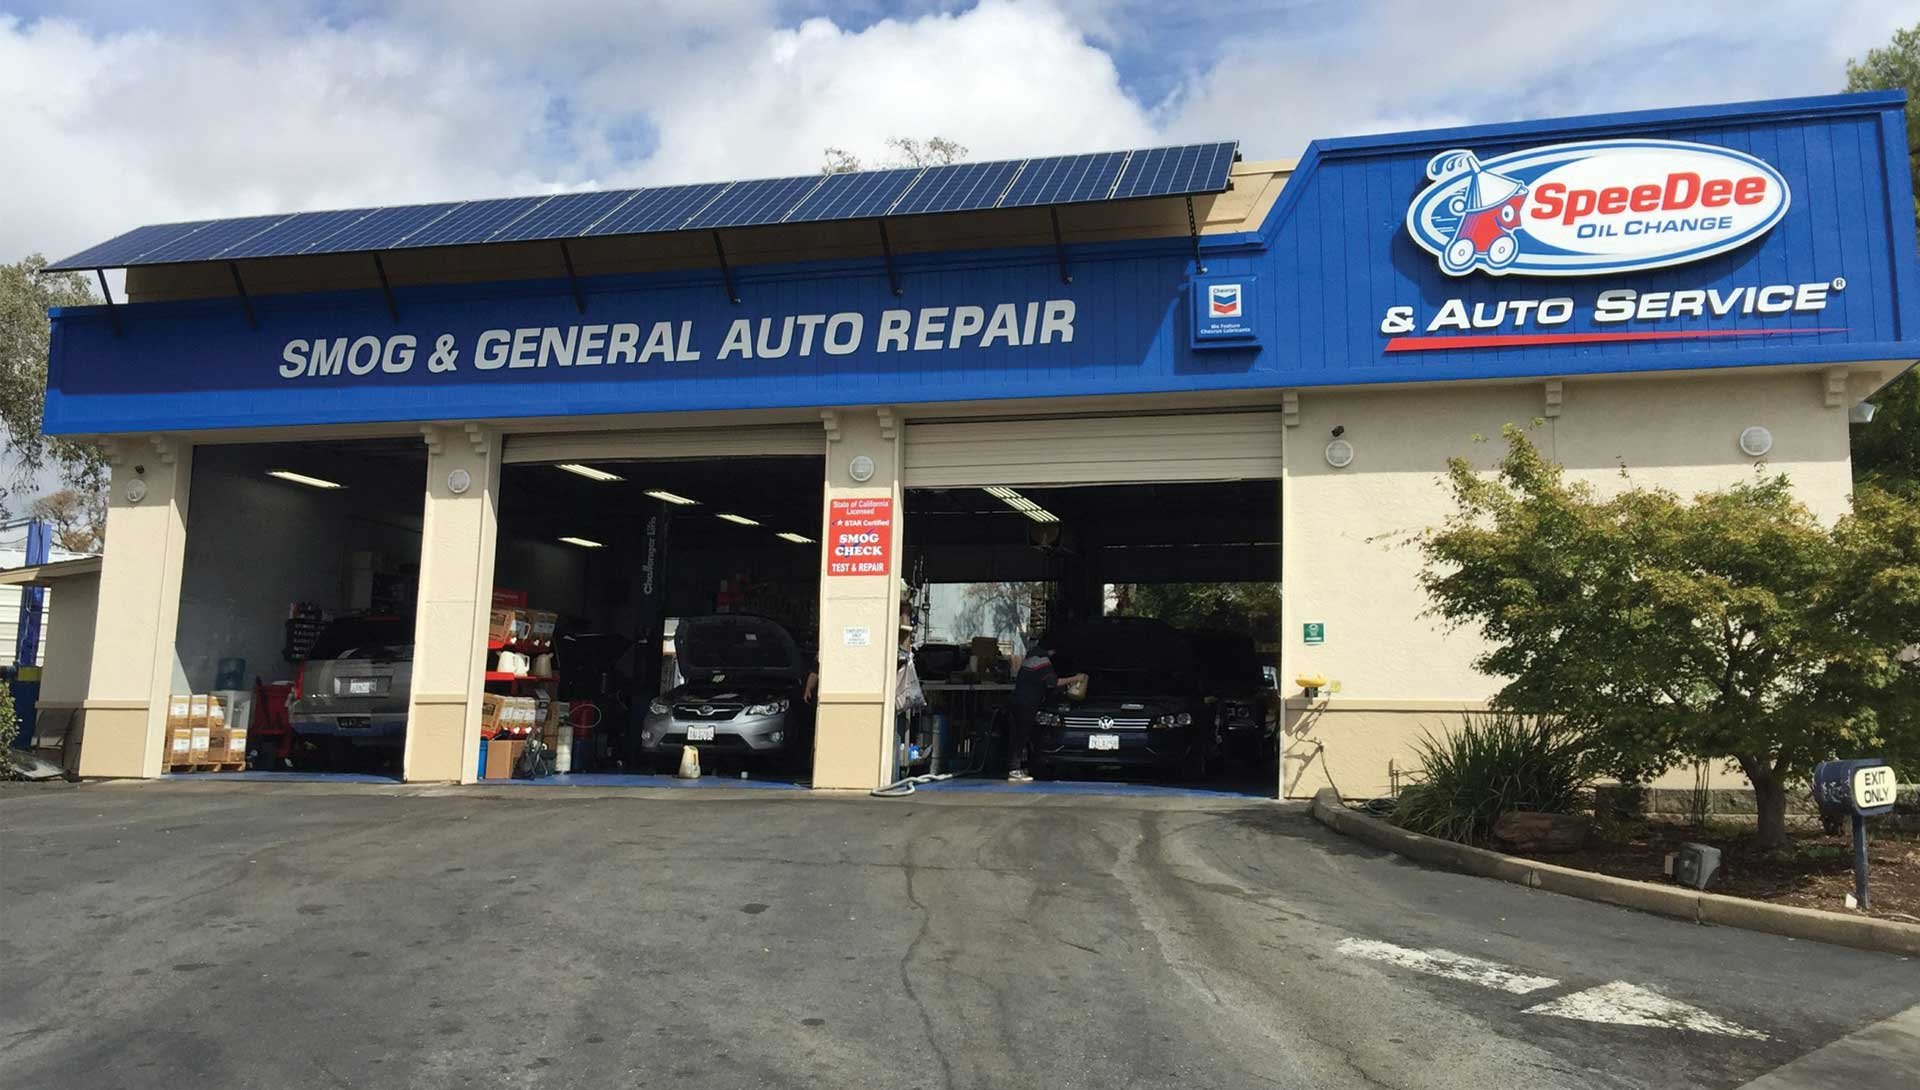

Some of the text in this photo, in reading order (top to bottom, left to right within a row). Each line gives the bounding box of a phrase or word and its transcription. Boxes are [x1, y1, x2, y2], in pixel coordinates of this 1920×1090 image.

[1530, 172, 1767, 226] SpeeDee
[1576, 215, 1733, 239] OIL CHANGE
[1380, 305, 1414, 334] &
[1427, 297, 1574, 332] AUTO
[278, 299, 1077, 379] SMOG & GENERAL AUTO REPAIR
[847, 507, 875, 515] Licensed
[839, 533, 879, 544] SMOG
[834, 545, 883, 557] CHECK
[642, 537, 656, 595] Challenger
[832, 562, 884, 572] TEST & REPAIR
[1864, 771, 1886, 786] EXIT
[1864, 787, 1889, 803] ONLY
